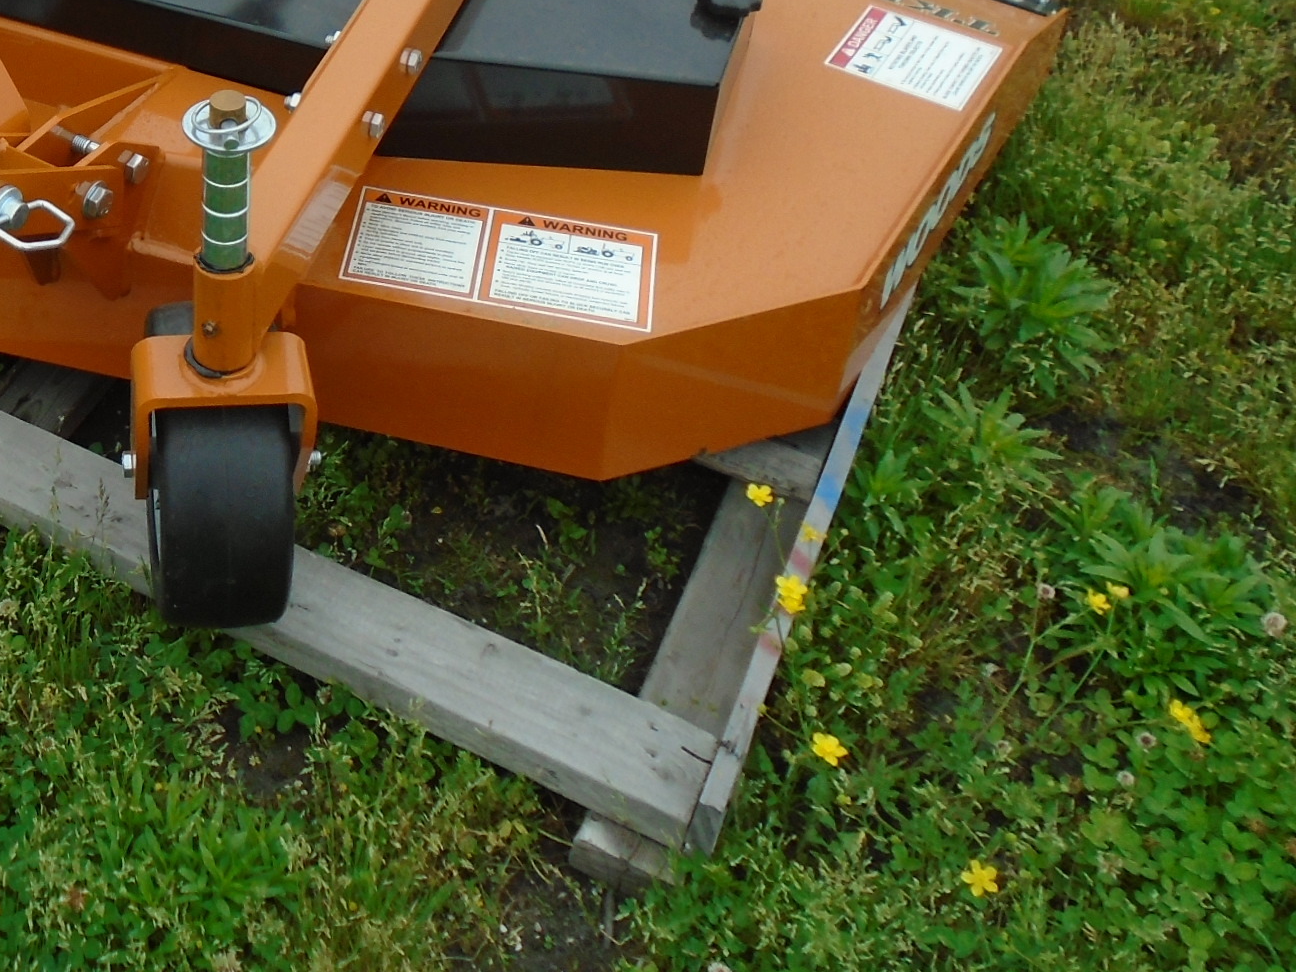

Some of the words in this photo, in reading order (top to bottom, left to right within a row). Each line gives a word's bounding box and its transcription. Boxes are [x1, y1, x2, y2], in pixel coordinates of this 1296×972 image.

[851, 16, 879, 49] DANGER
[399, 196, 482, 218] WARNING
[880, 112, 996, 310] WOODS
[543, 219, 628, 242] WARNING
